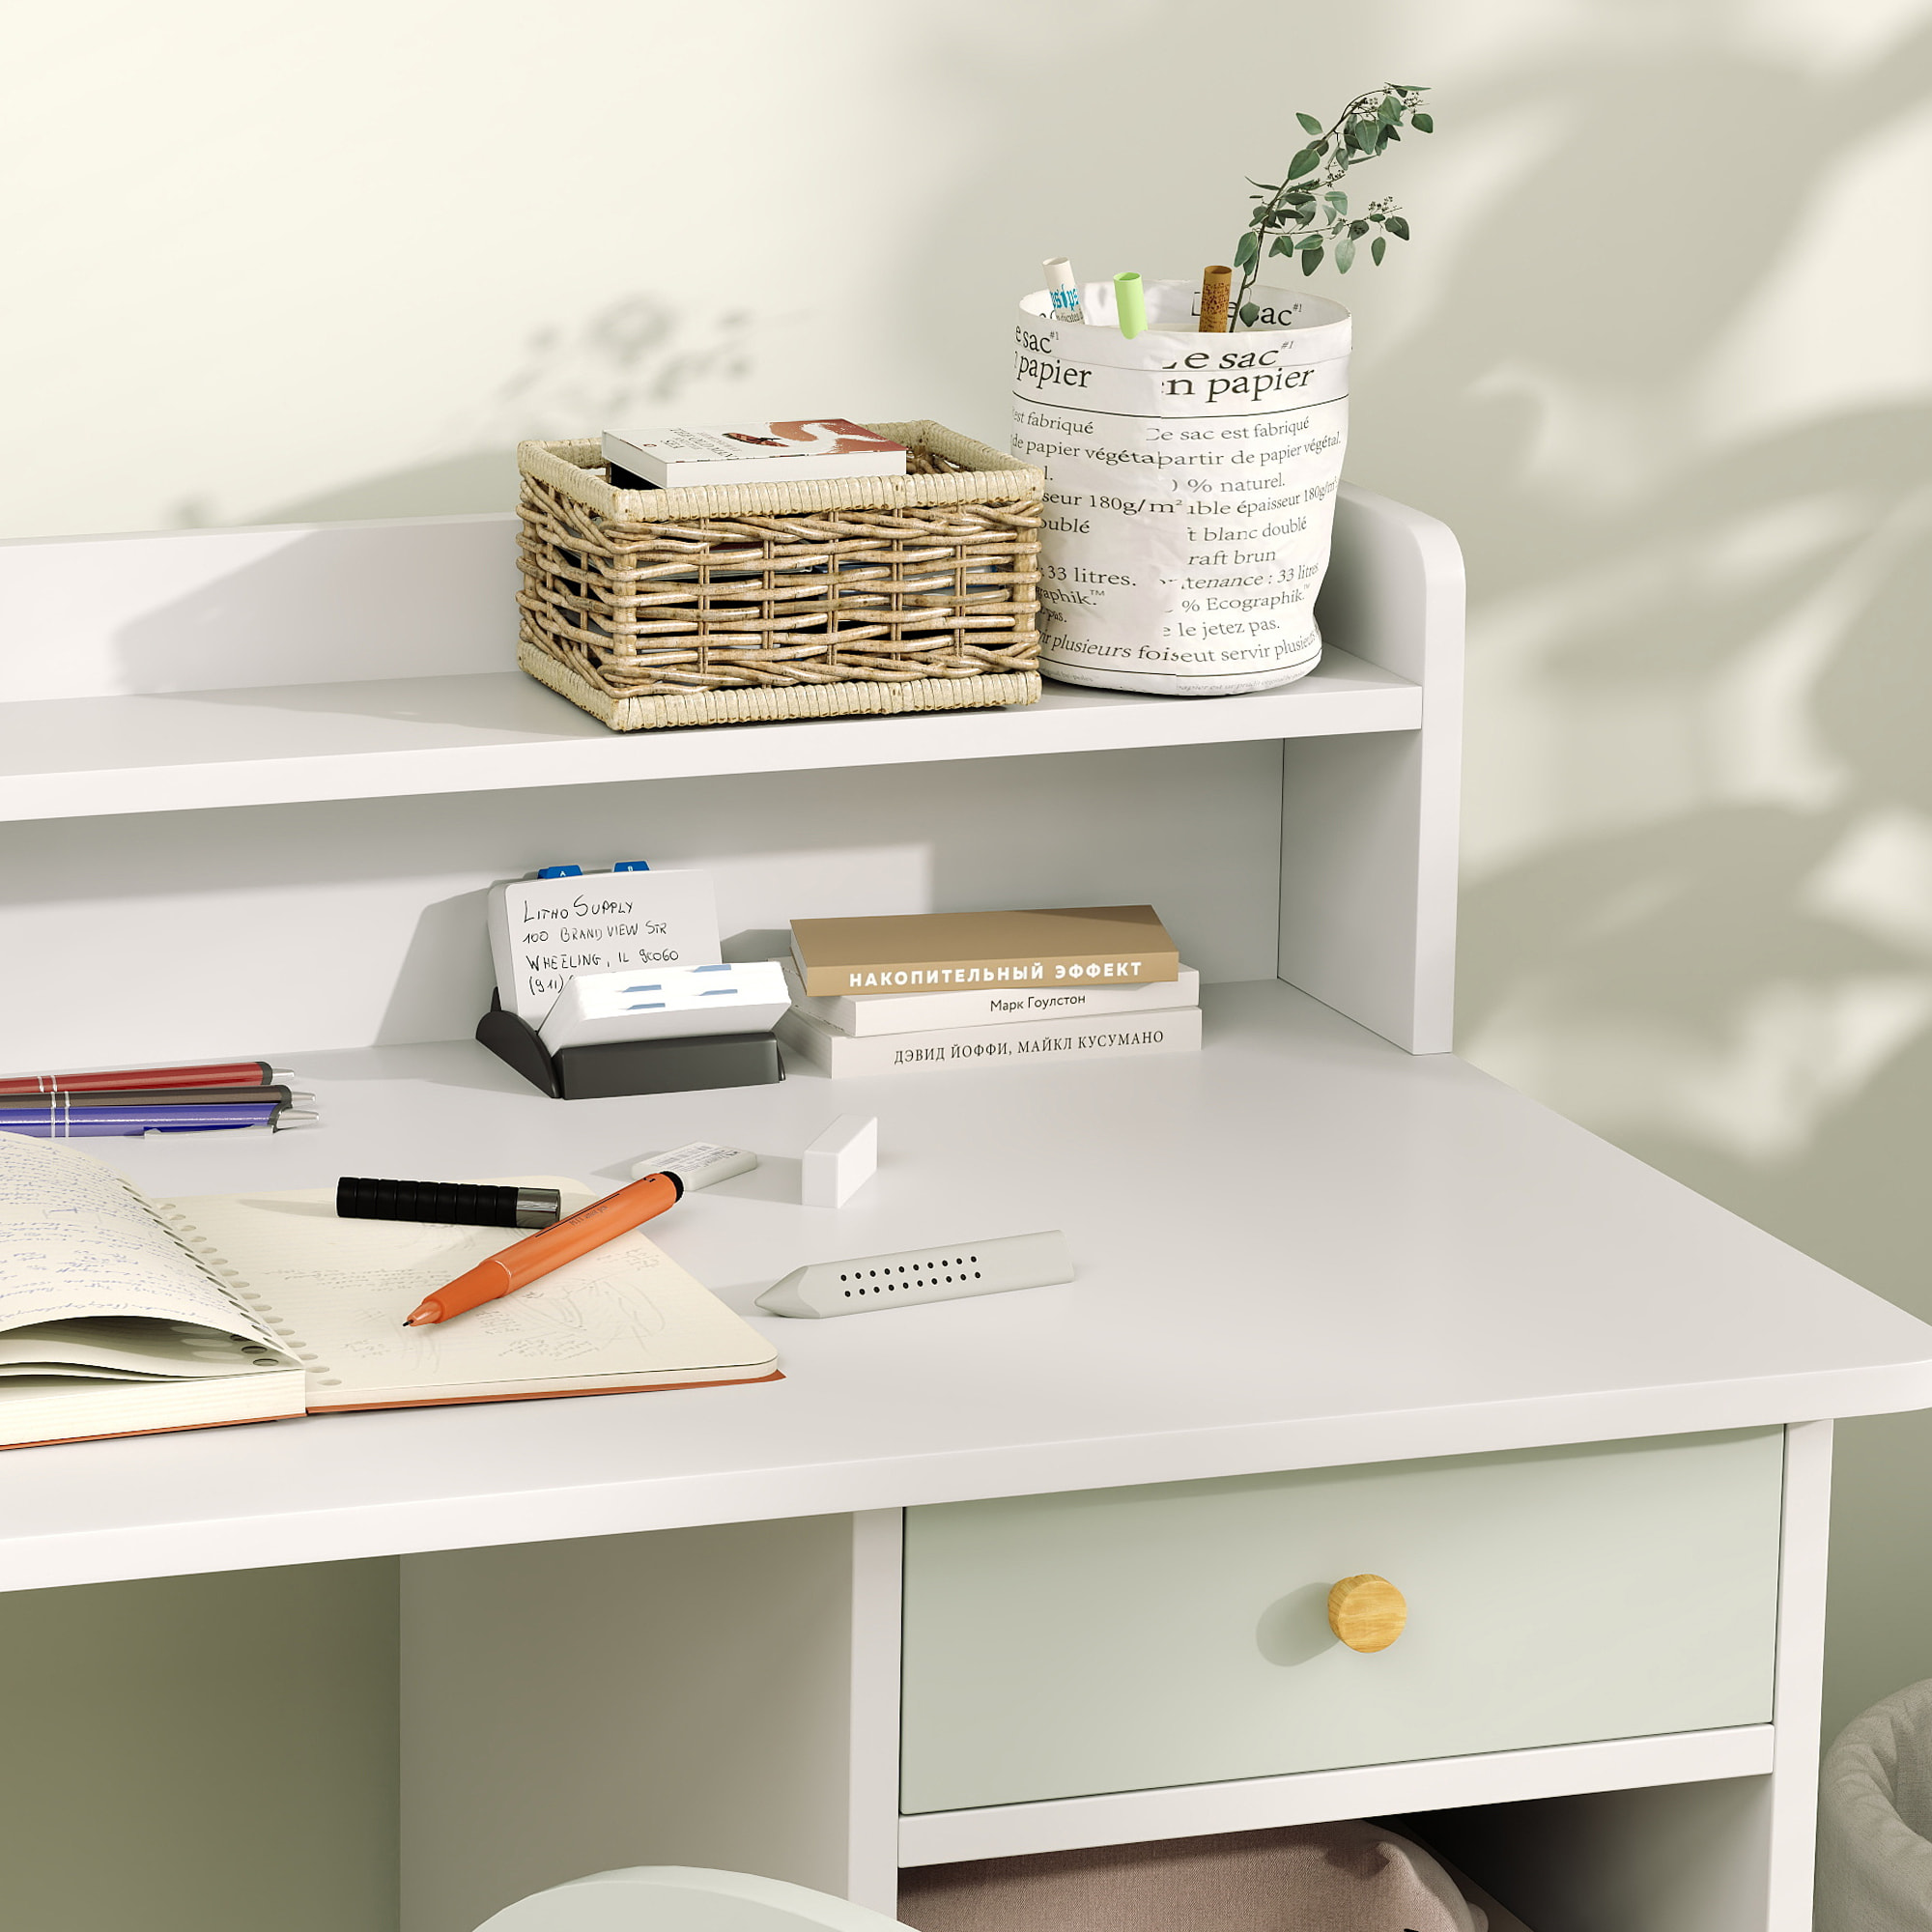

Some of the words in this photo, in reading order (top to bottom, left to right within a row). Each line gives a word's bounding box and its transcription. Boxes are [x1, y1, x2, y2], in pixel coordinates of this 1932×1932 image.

[1016, 355, 1093, 389] papier
[1205, 367, 1315, 404] papier
[1027, 412, 1094, 436] fabriqué
[1179, 429, 1215, 440] sac
[1220, 427, 1249, 440] est
[1253, 415, 1310, 440] fabriqué
[1026, 440, 1081, 458] papier
[1231, 449, 1255, 464] de
[1260, 445, 1302, 467] papier
[1236, 494, 1301, 518] épaisseur
[1204, 527, 1259, 542] blanc
[1262, 516, 1307, 538] doublé
[1234, 550, 1276, 565] brun
[1276, 568, 1295, 583] 33
[1178, 622, 1197, 637] le
[1202, 621, 1246, 640] jetez
[1248, 619, 1280, 637] pas.
[1051, 634, 1132, 658] plusieurs
[1221, 644, 1270, 662] servir
[522, 930, 549, 944] 100
[849, 962, 1045, 988] НАКОПИТЕЛЬНЫЙ
[1055, 961, 1143, 980] ЭФФЕКТ
[989, 999, 1025, 1013] Марк
[1027, 993, 1087, 1010] Гоулстон
[894, 1047, 946, 1065] ДЭВИД
[951, 1043, 1013, 1059] ЙОФФИ,
[1017, 1035, 1073, 1055] МАЙКЛ
[1077, 1030, 1164, 1049] КУСУМАНО
